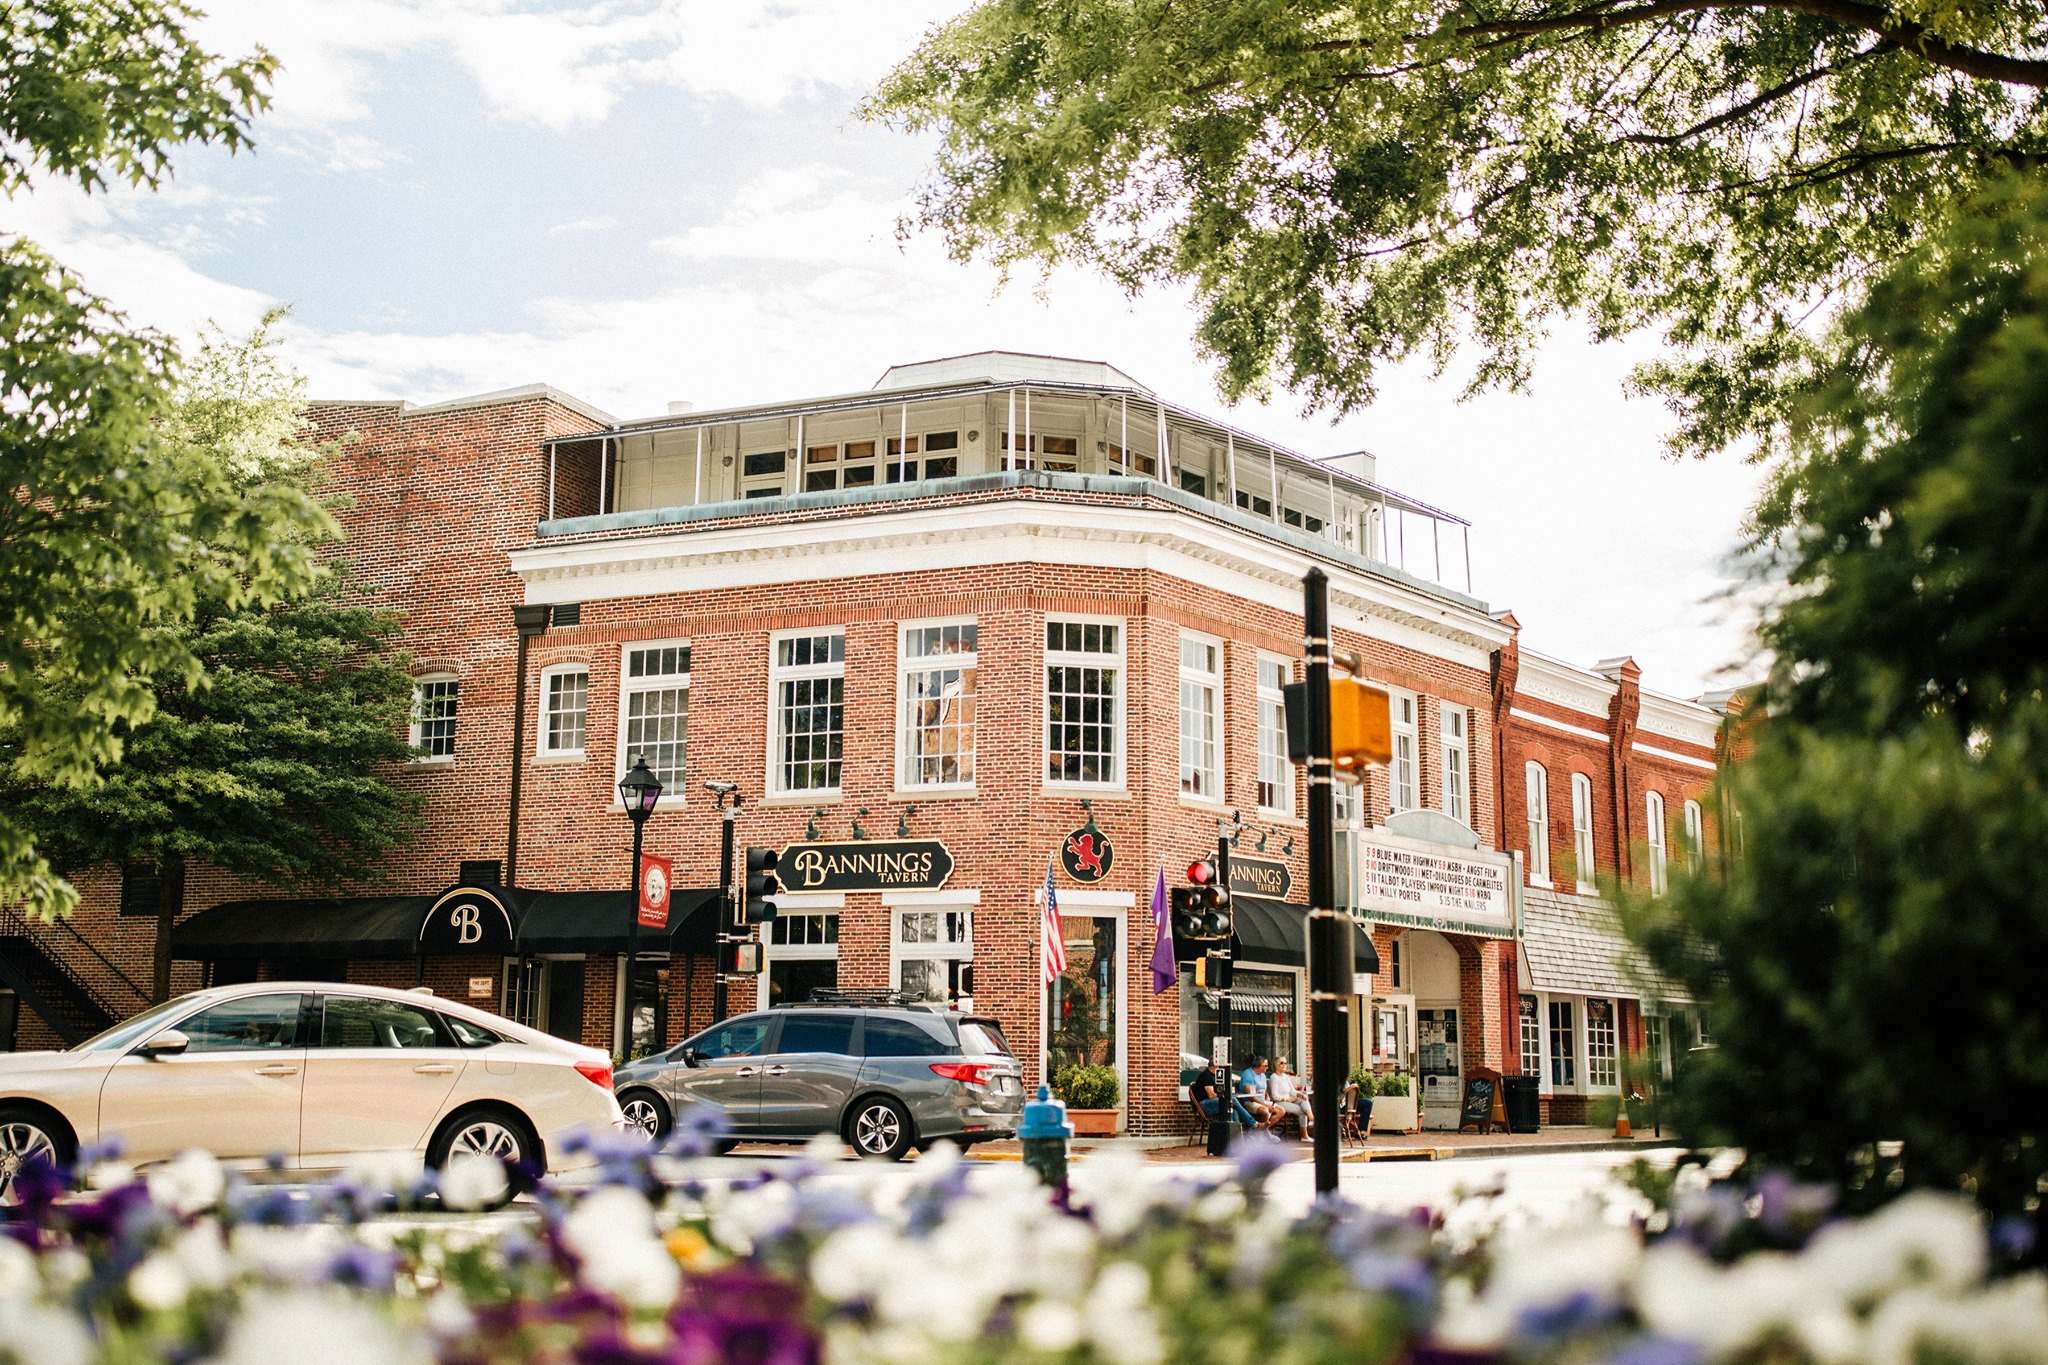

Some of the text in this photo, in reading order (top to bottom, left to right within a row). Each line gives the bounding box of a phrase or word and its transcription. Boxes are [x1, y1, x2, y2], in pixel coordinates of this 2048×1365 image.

[795, 850, 932, 886] BANNINGS
[878, 871, 929, 883] TAVERN
[1230, 864, 1282, 885] ANNINGS
[1366, 847, 1370, 857] 5
[1371, 848, 1376, 858] 9
[1377, 849, 1392, 861] BLUE
[1393, 852, 1411, 864] WATER
[1413, 855, 1437, 869] HIGHWAY
[1466, 865, 1483, 876] ANGST
[1485, 868, 1497, 878] FILM
[1366, 860, 1370, 870] 5
[1378, 862, 1411, 876] DRIFTWOOD
[1465, 876, 1472, 887] DE
[1473, 878, 1503, 891] CARMELITES
[1256, 883, 1281, 892] TAVERN
[1366, 872, 1370, 882] 5
[1377, 874, 1400, 886] TALBOT
[1401, 878, 1426, 891] PLAYERS
[1427, 882, 1447, 894] IMPROV
[1448, 885, 1463, 897] NIGHT
[1476, 890, 1491, 901] NRBQ
[1367, 884, 1371, 894] 5
[1372, 885, 1377, 895] 17
[1379, 886, 1397, 898] WILLY
[1398, 889, 1422, 902] PORTER
[1451, 897, 1462, 908] THE
[451, 904, 482, 943] B
